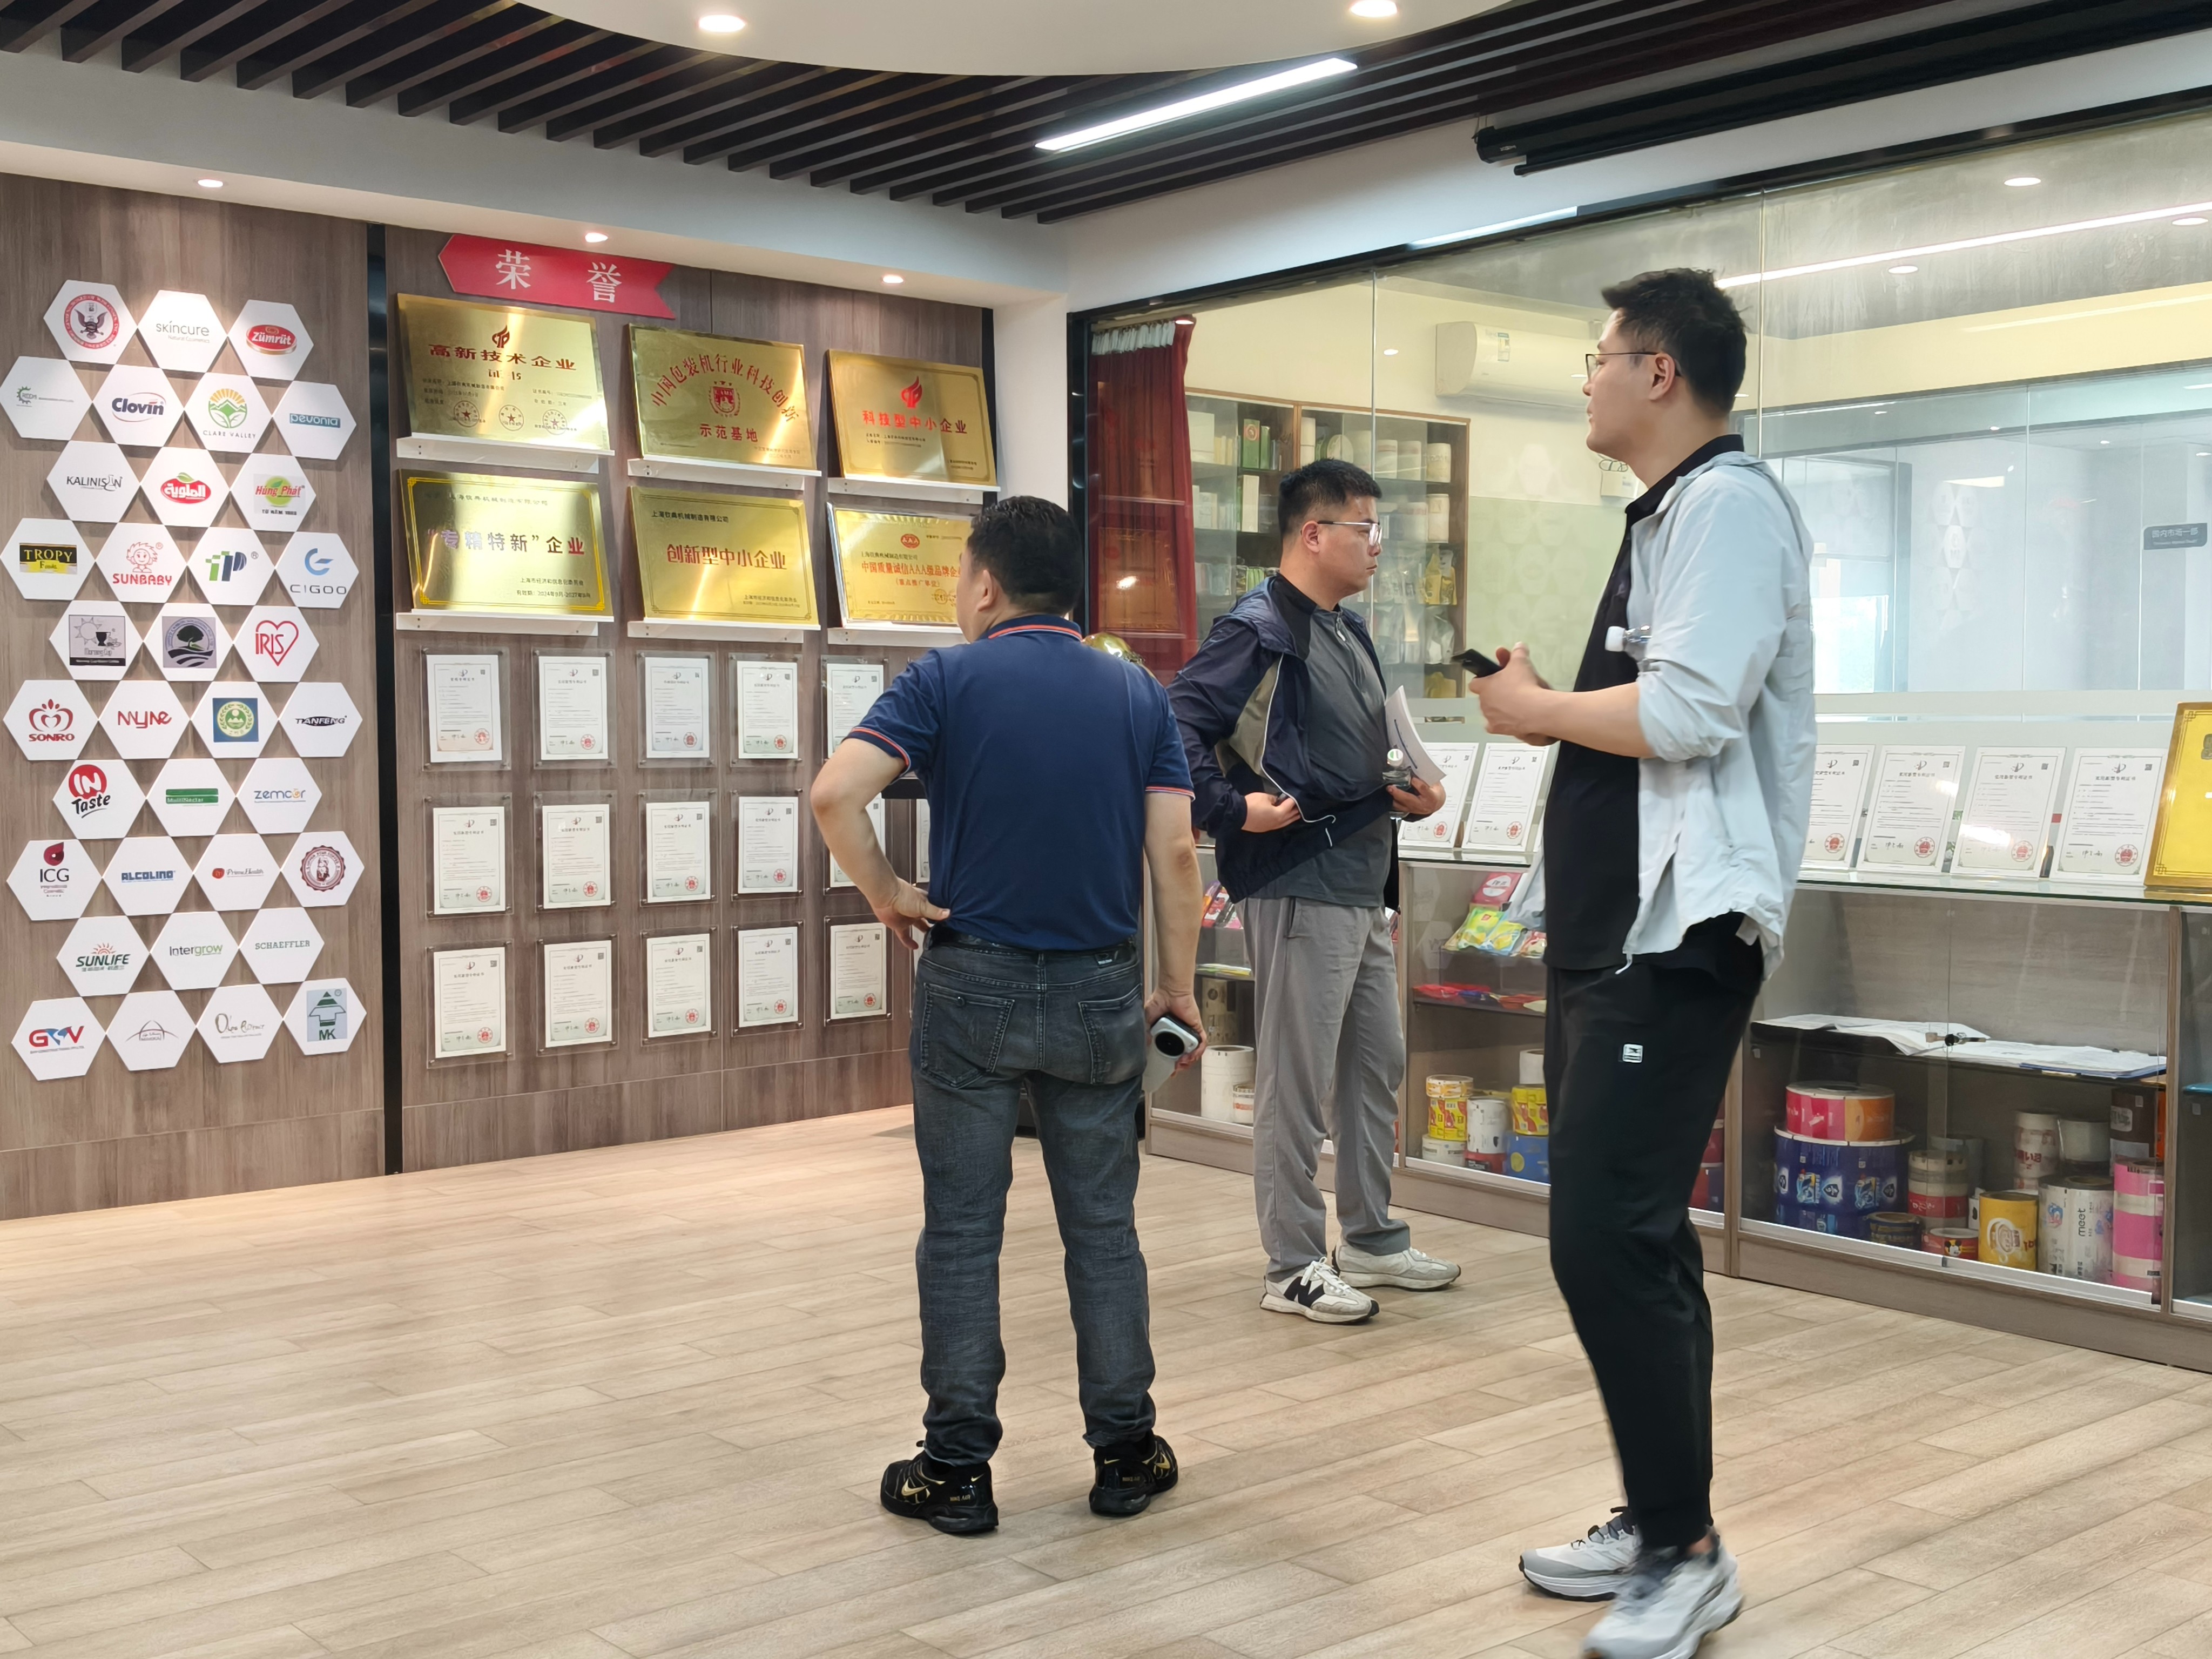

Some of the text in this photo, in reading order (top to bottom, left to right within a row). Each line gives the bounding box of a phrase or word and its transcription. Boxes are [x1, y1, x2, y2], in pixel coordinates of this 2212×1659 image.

[495, 248, 622, 303] 荣誉
[156, 321, 210, 336] skincure
[252, 331, 292, 345] Zümrüt
[428, 343, 577, 371] 高新技术企业
[290, 414, 339, 426] pevonia
[862, 410, 968, 434] 科技型中小企业
[699, 423, 758, 442] 示范基地
[24, 549, 73, 562] TROPY
[666, 543, 787, 570] 创新型中小企业
[112, 573, 172, 585] SUNBABY
[255, 633, 285, 655] IRIS
[295, 716, 346, 727] TANFENG
[29, 733, 75, 742] SONRO
[73, 772, 102, 795] IN
[254, 788, 306, 799] zemcor
[71, 794, 111, 815] Taste
[39, 868, 70, 883] ICG
[169, 944, 223, 956] Intergrow
[254, 940, 311, 950] SCHAEFFLER
[75, 954, 131, 968] SUNLIFE
[319, 1029, 336, 1041] MK
[2078, 1208, 2086, 1237] meet
